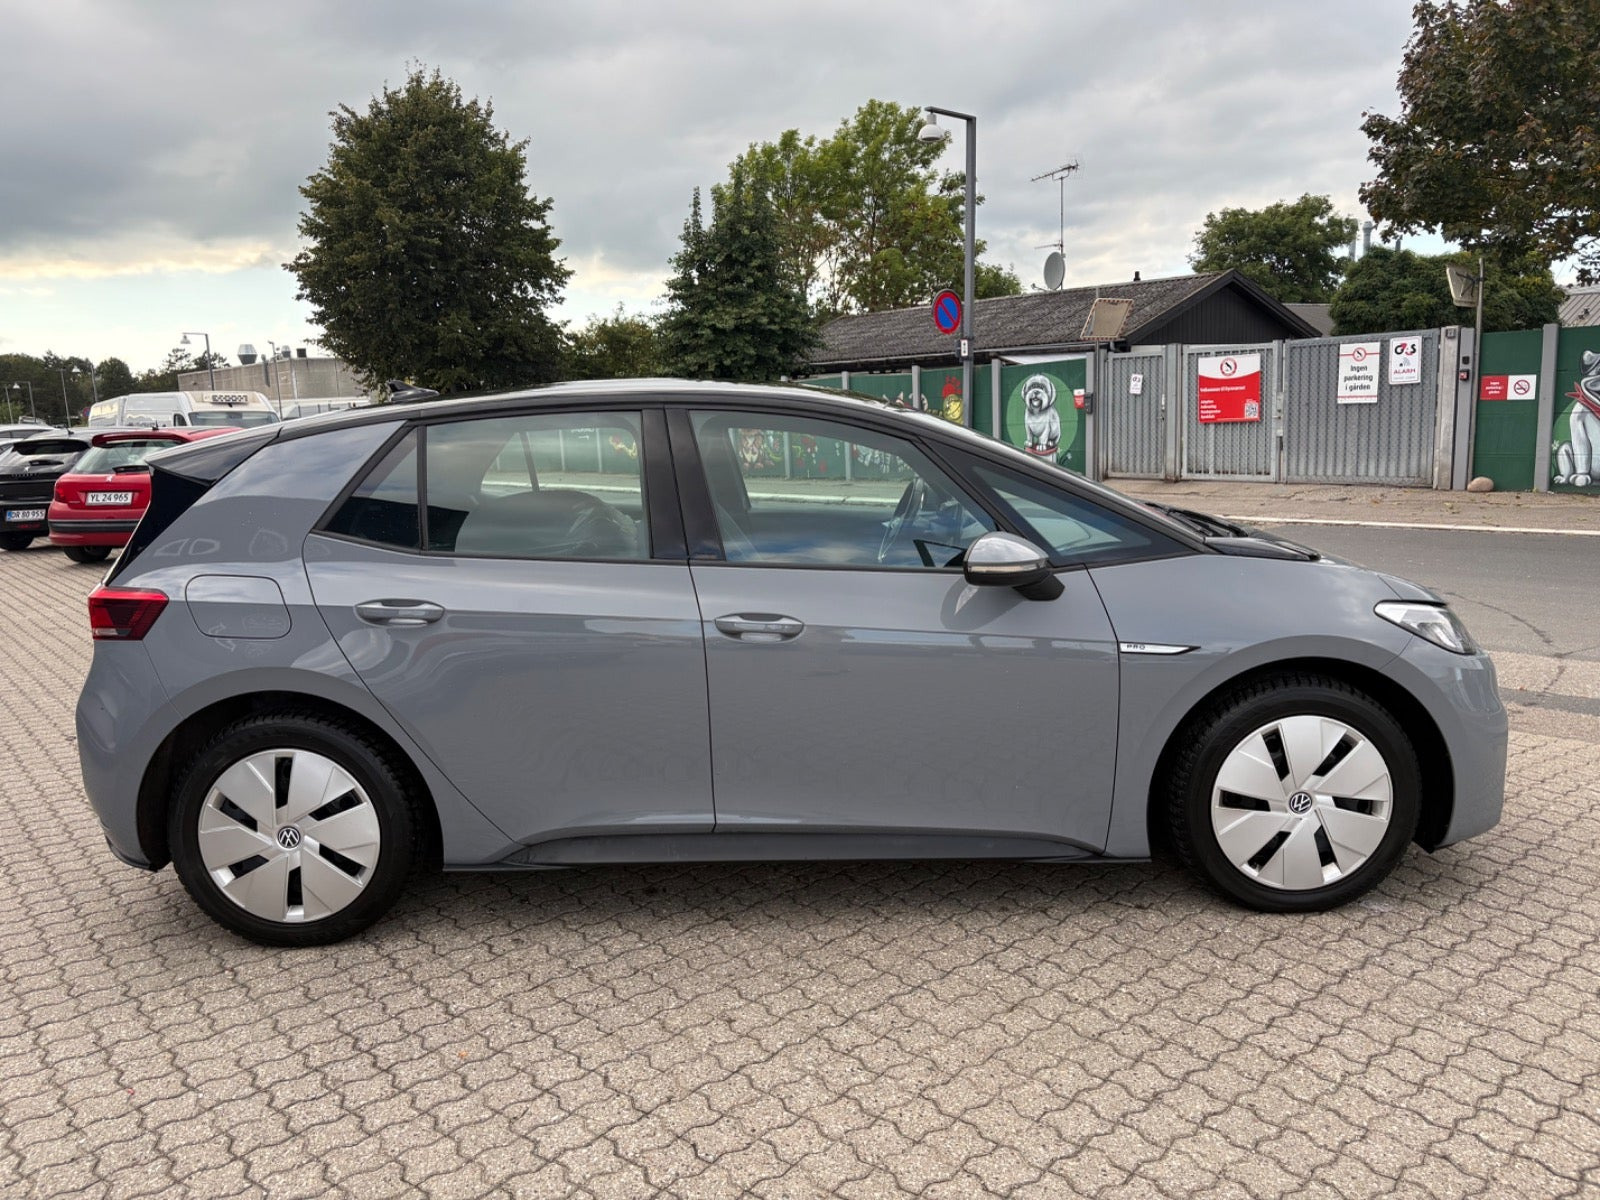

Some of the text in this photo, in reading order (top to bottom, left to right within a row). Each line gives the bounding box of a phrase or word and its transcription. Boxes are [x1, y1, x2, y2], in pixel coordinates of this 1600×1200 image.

[1395, 343, 1416, 355] G4S
[1344, 374, 1373, 382] parkering
[1349, 383, 1370, 391] gården
[91, 493, 129, 502] YL 24 965
